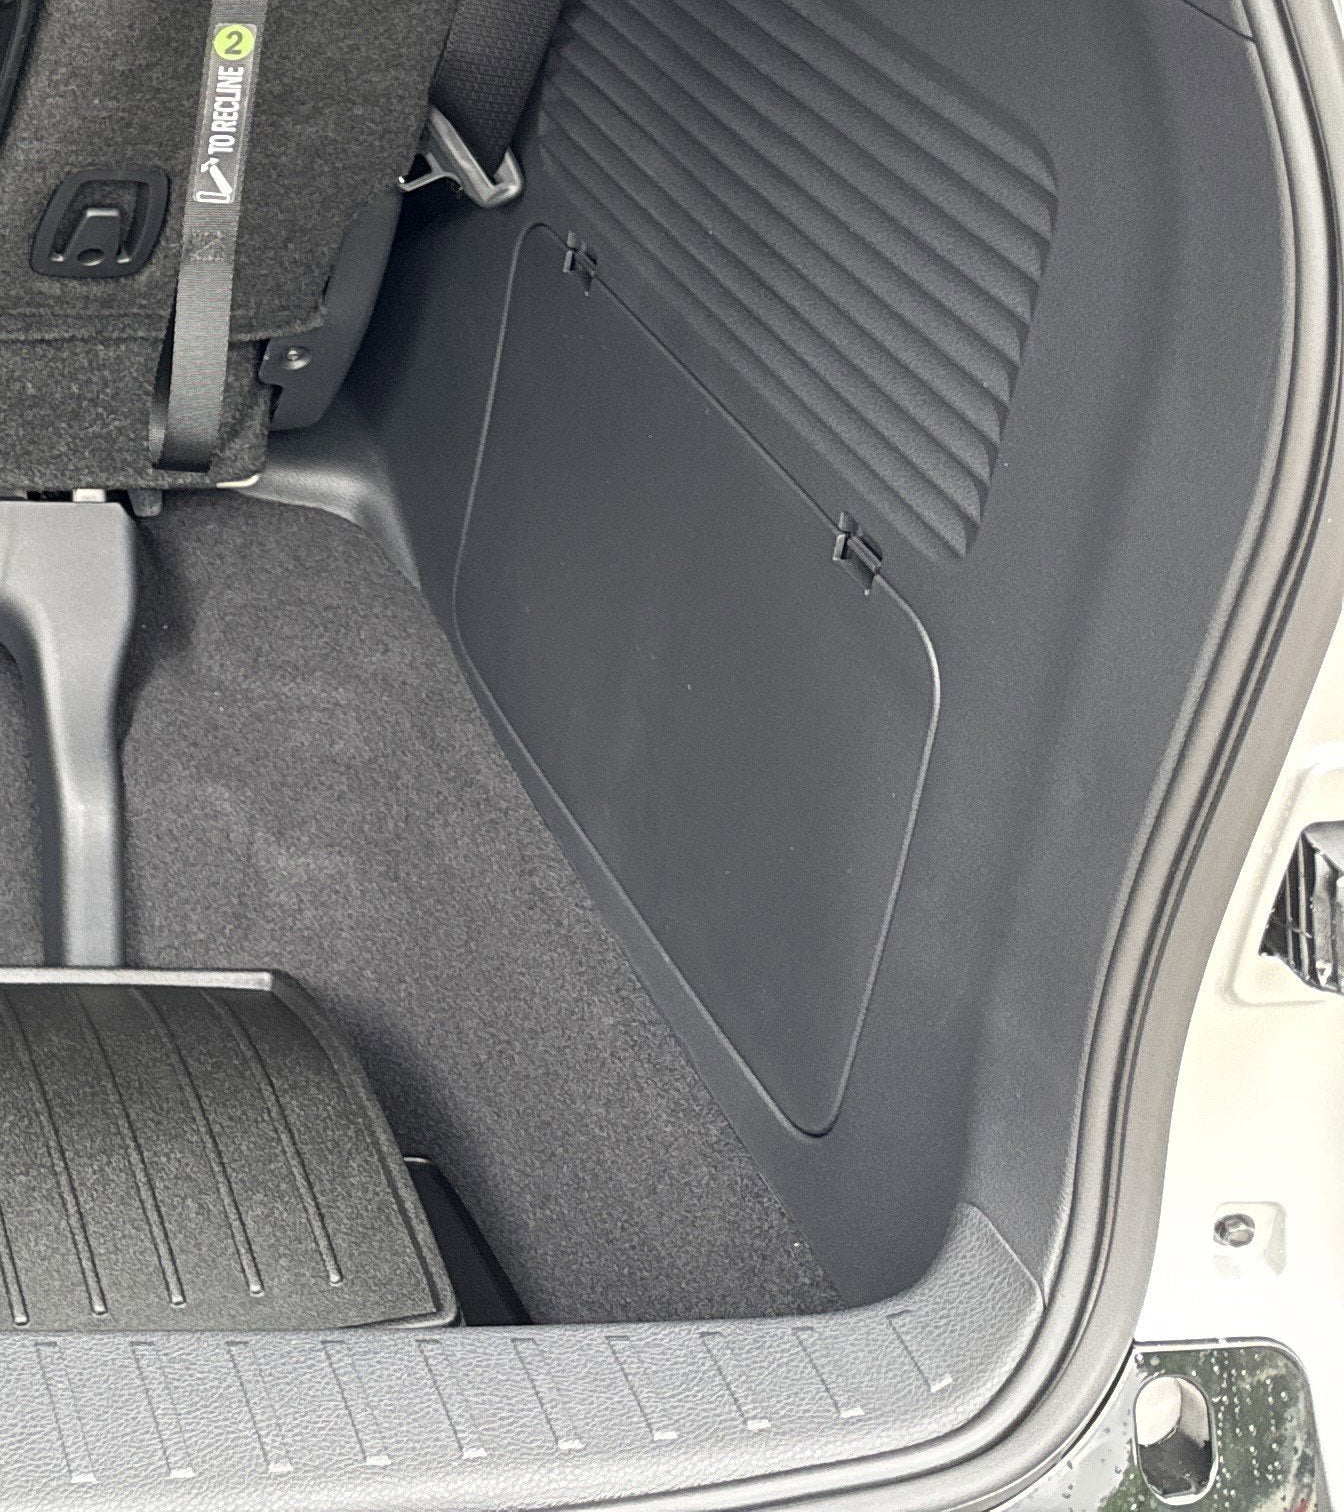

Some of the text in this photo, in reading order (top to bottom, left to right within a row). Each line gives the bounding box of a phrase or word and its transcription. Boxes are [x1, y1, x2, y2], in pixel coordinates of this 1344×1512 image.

[224, 30, 244, 55] 2
[207, 65, 244, 155] TO RECLINE
